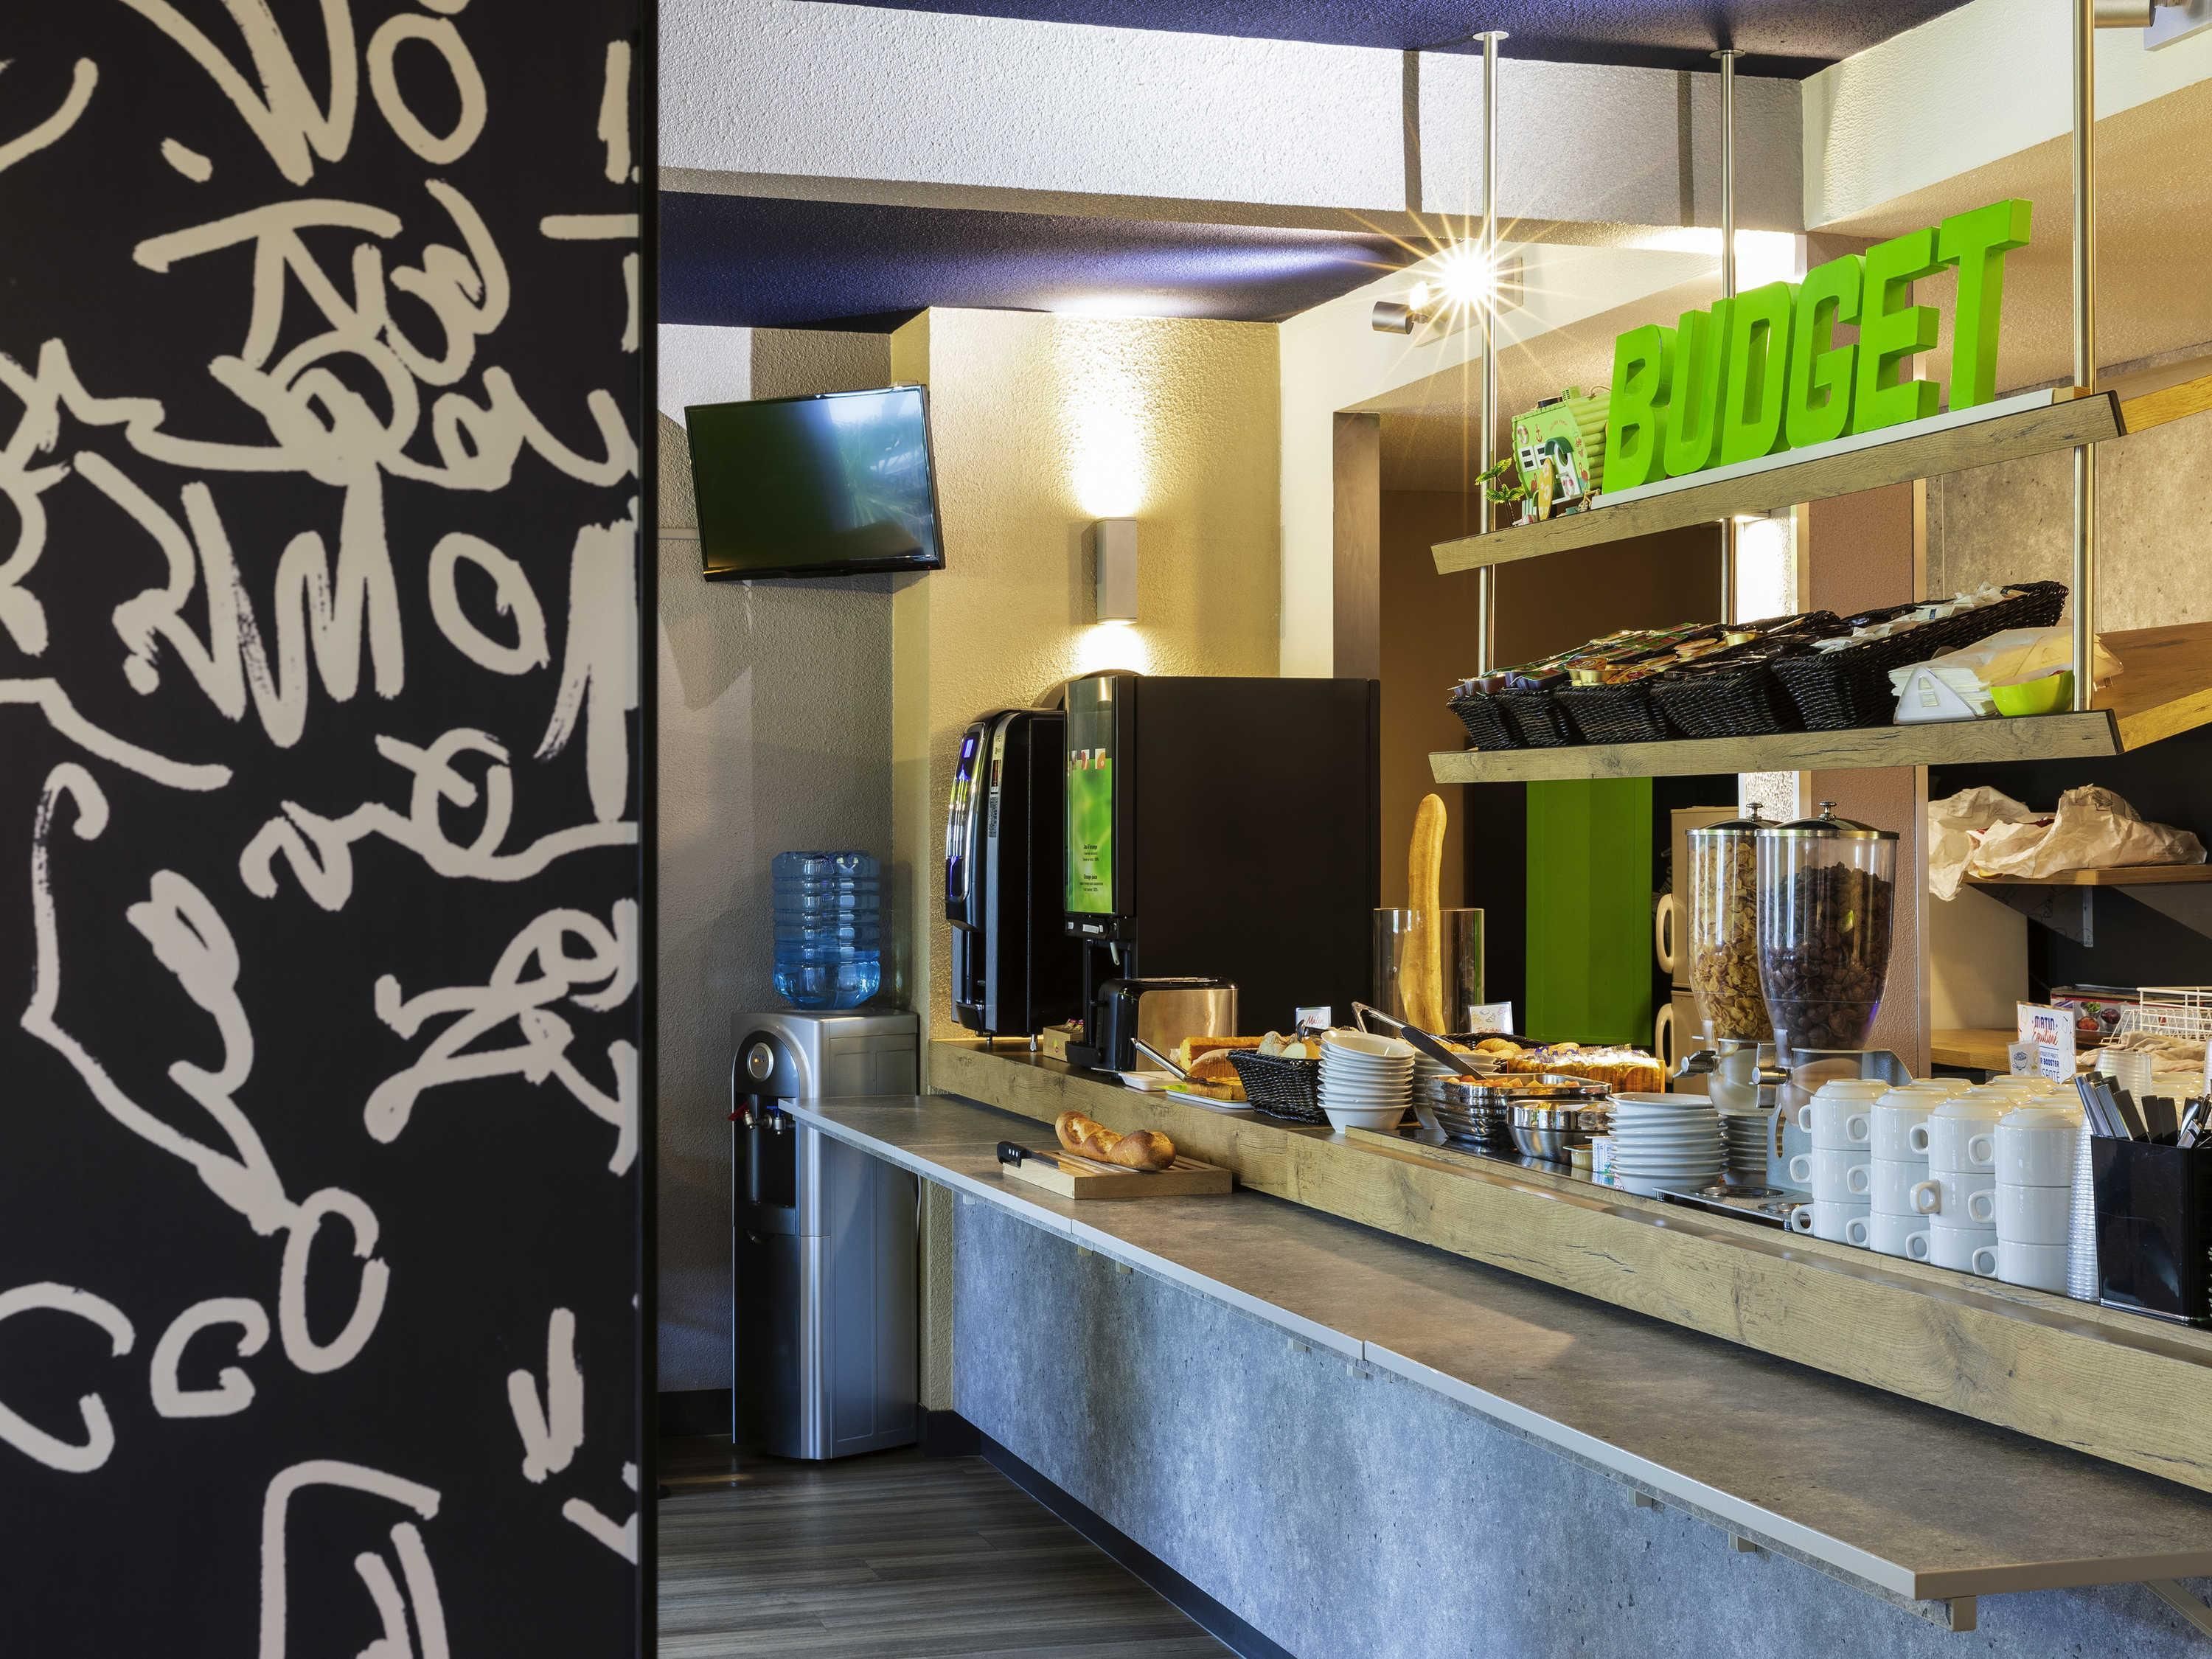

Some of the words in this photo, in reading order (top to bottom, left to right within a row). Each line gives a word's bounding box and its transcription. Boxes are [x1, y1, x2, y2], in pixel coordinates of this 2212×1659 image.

[1602, 198, 2032, 494] BUDGET
[2034, 1015, 2055, 1031] MATIN
[2043, 1057, 2059, 1068] BOOSTER
